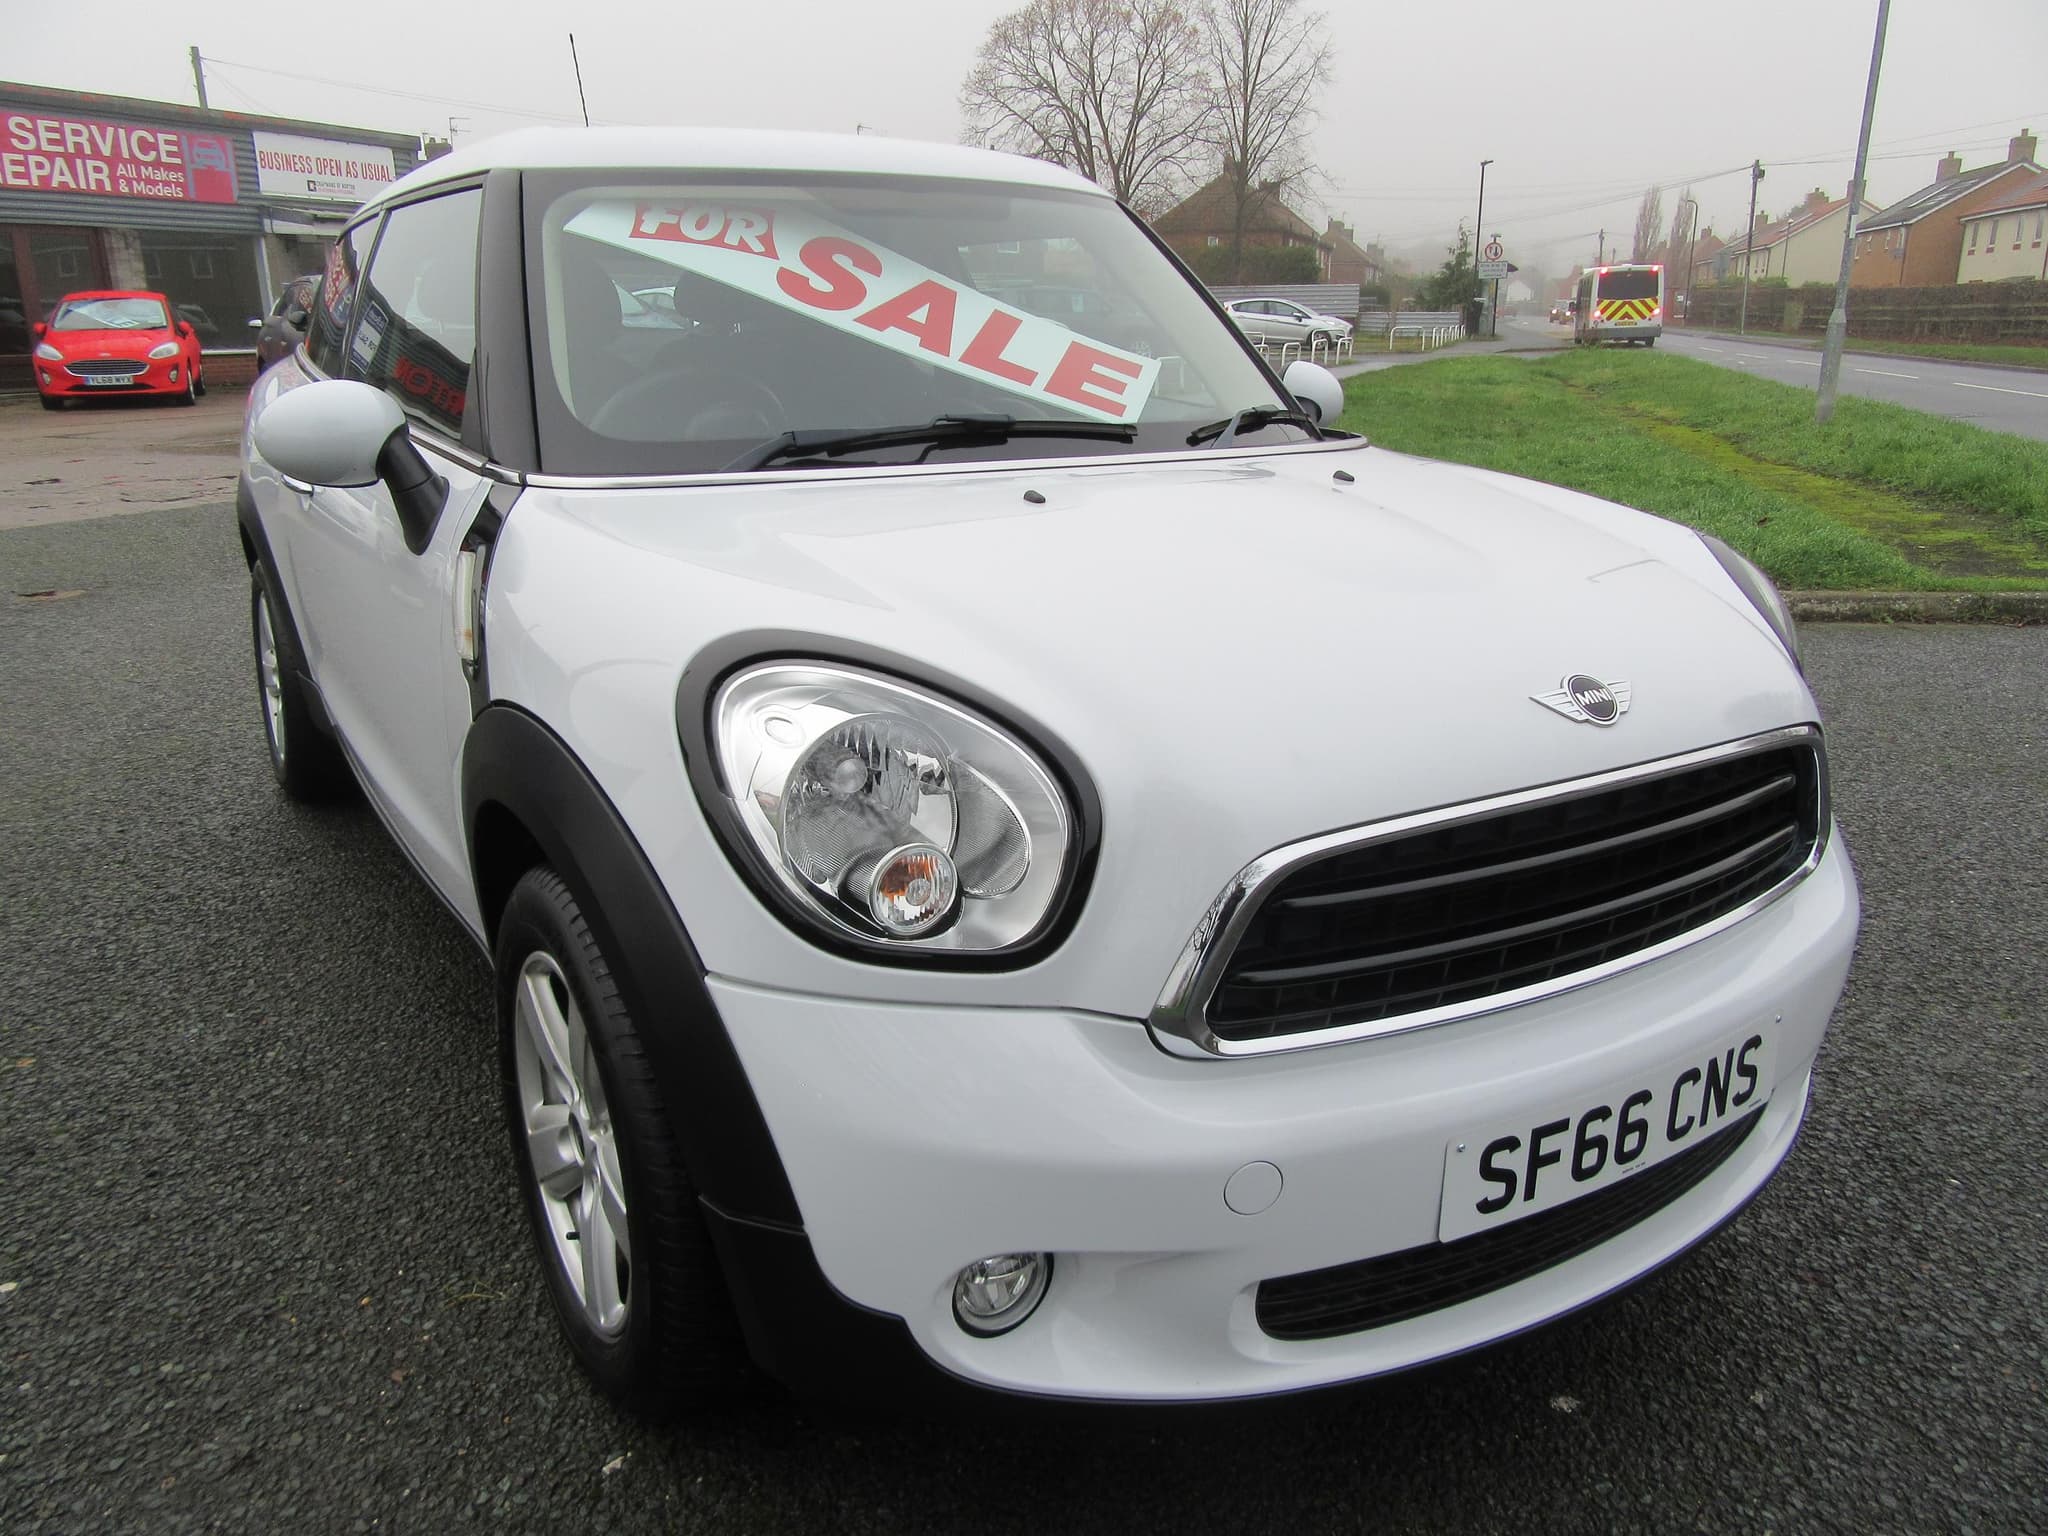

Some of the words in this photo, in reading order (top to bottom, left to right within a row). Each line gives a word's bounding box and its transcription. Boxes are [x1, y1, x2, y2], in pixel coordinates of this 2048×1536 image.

[8, 116, 182, 164] SERVICE
[0, 152, 112, 191] EPAIR
[117, 164, 136, 177] All
[141, 166, 184, 182] Makes
[259, 150, 313, 174] BUSINESS
[316, 157, 342, 177] OPEN
[346, 162, 359, 179] AS
[361, 164, 393, 182] USUAL
[119, 179, 130, 193] &
[133, 181, 184, 198] Models
[640, 205, 769, 251] FOR
[777, 236, 1142, 416] SALE
[1575, 688, 1612, 706] MINI
[1476, 1089, 1653, 1214] SF66
[1667, 1034, 1762, 1142] CNS
